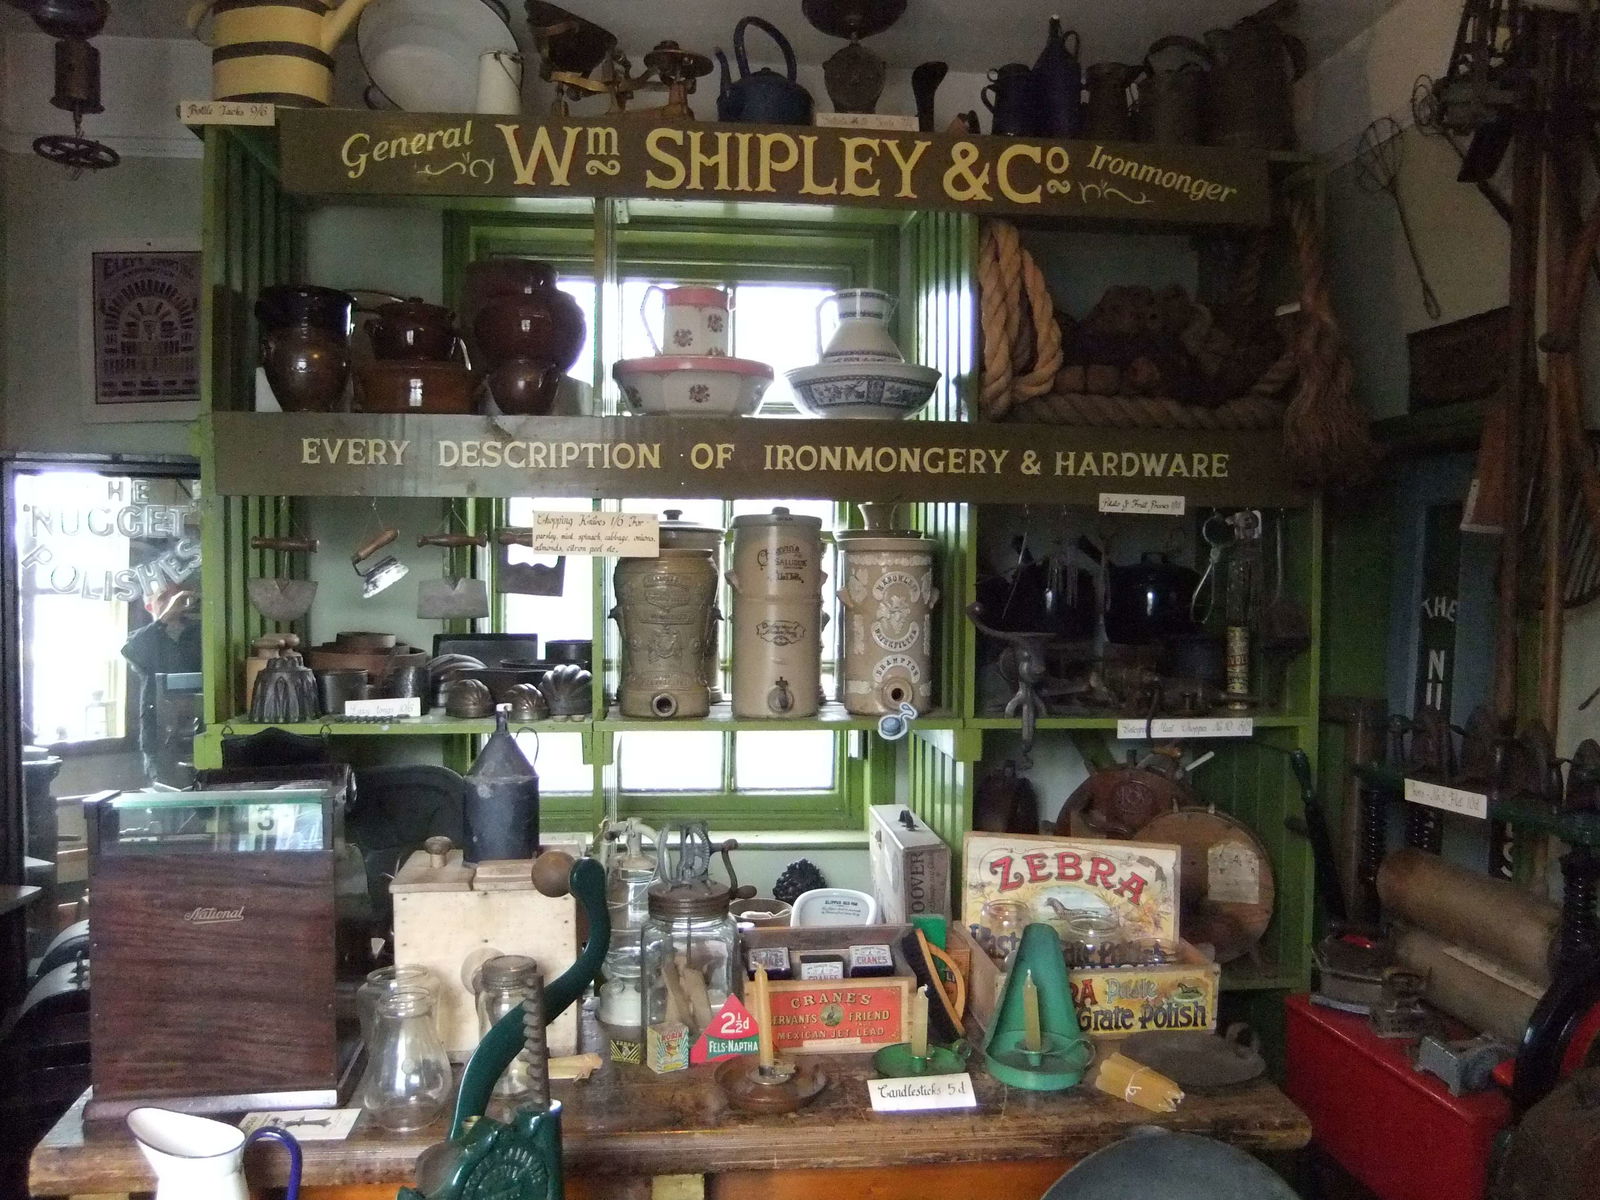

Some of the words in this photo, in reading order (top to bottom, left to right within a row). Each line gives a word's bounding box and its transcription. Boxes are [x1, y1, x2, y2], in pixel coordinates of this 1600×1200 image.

[341, 120, 474, 179] General
[495, 123, 621, 187] Wm
[645, 127, 932, 198] SHIPLEY
[1087, 144, 1237, 202] Ironmonger
[300, 437, 410, 466] EVERY
[438, 440, 662, 470] DESCRIPTION
[690, 442, 736, 471] OF
[763, 445, 1010, 475] IRONMONGERY
[1020, 450, 1041, 475] &
[1054, 451, 1230, 478] HARDWARE
[536, 513, 574, 529] Chopping
[579, 513, 606, 526] Knives
[21, 537, 202, 602] POLISHES
[1421, 596, 1458, 622] THE
[875, 656, 920, 677] BRAMPTON
[910, 851, 926, 914] OOVER
[989, 851, 1149, 906] ZEBRA
[184, 906, 244, 924] National
[773, 1013, 818, 1026] ERVANTS
[849, 1009, 890, 1022] FRIEND
[1078, 1005, 1135, 1031] Grate
[1139, 999, 1208, 1030] Polish
[778, 1030, 827, 1040] MEXICAN
[831, 1030, 851, 1039] JET
[856, 1026, 885, 1037] LEAD
[878, 1084, 941, 1099] Candlesticks
